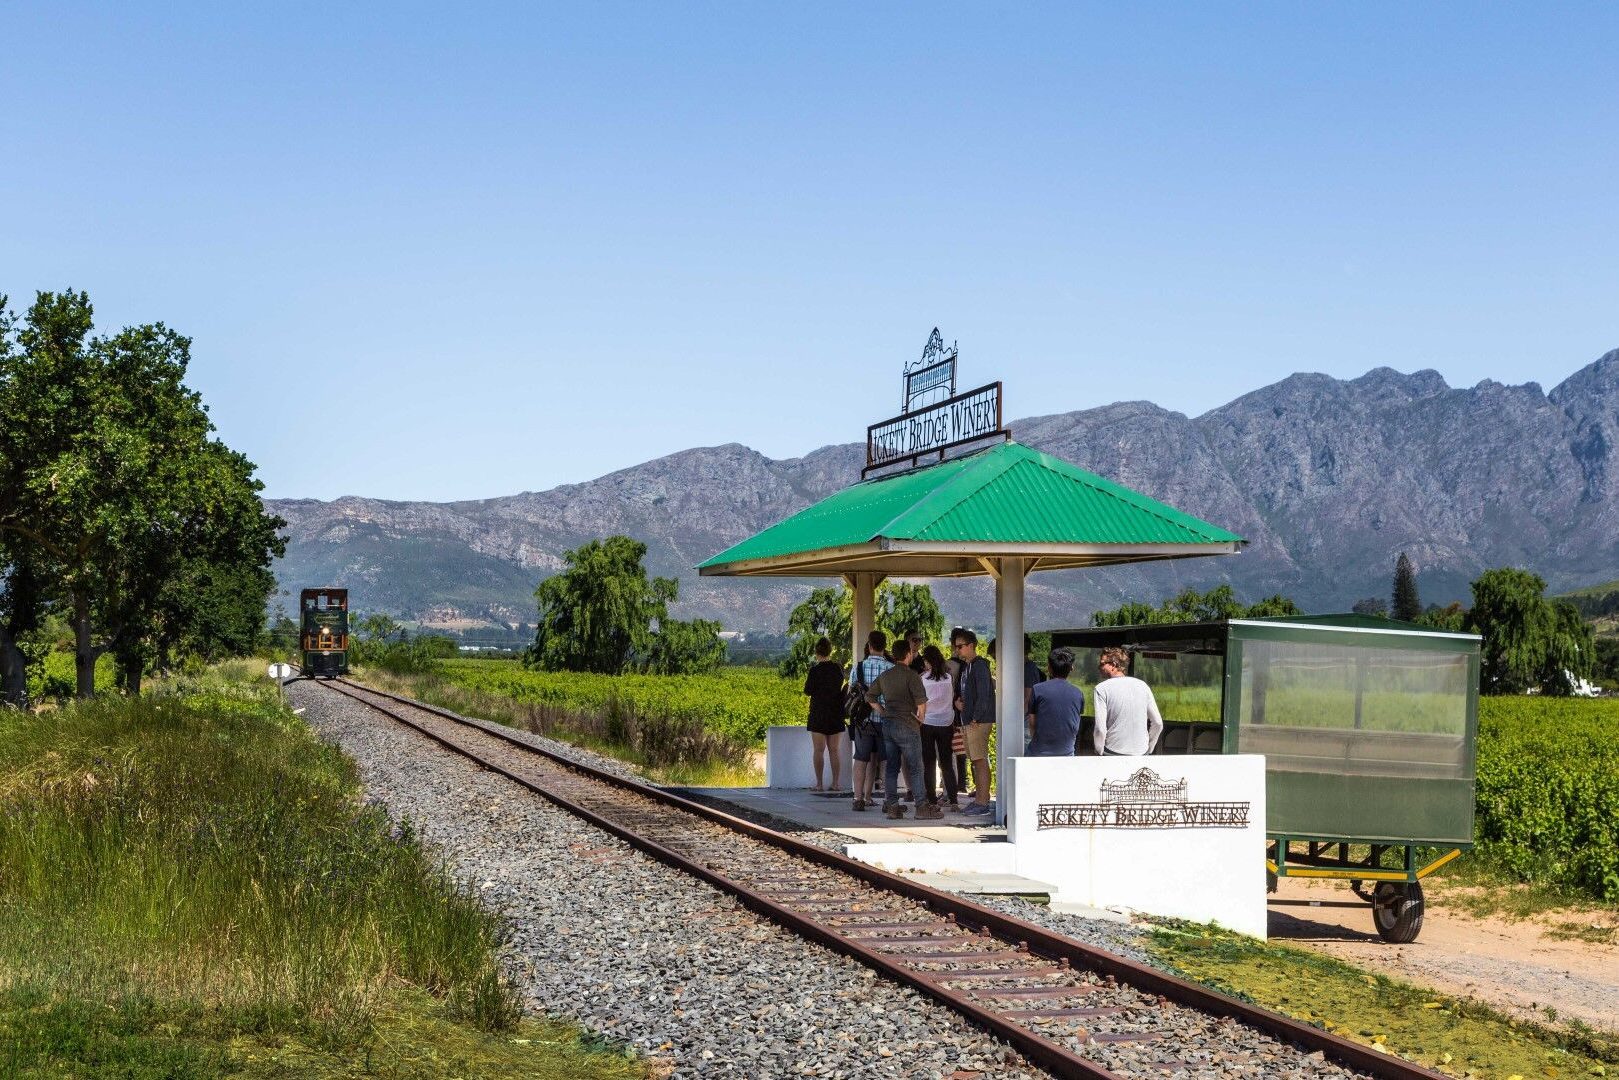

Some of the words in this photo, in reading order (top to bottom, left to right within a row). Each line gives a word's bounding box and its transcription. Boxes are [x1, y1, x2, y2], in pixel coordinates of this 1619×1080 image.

[909, 414, 948, 451] BRIDGE
[951, 397, 997, 440] WINERY
[1038, 807, 1109, 825] RICKETY
[1115, 806, 1178, 825] BRIDGE
[1181, 805, 1249, 824] WINERY
